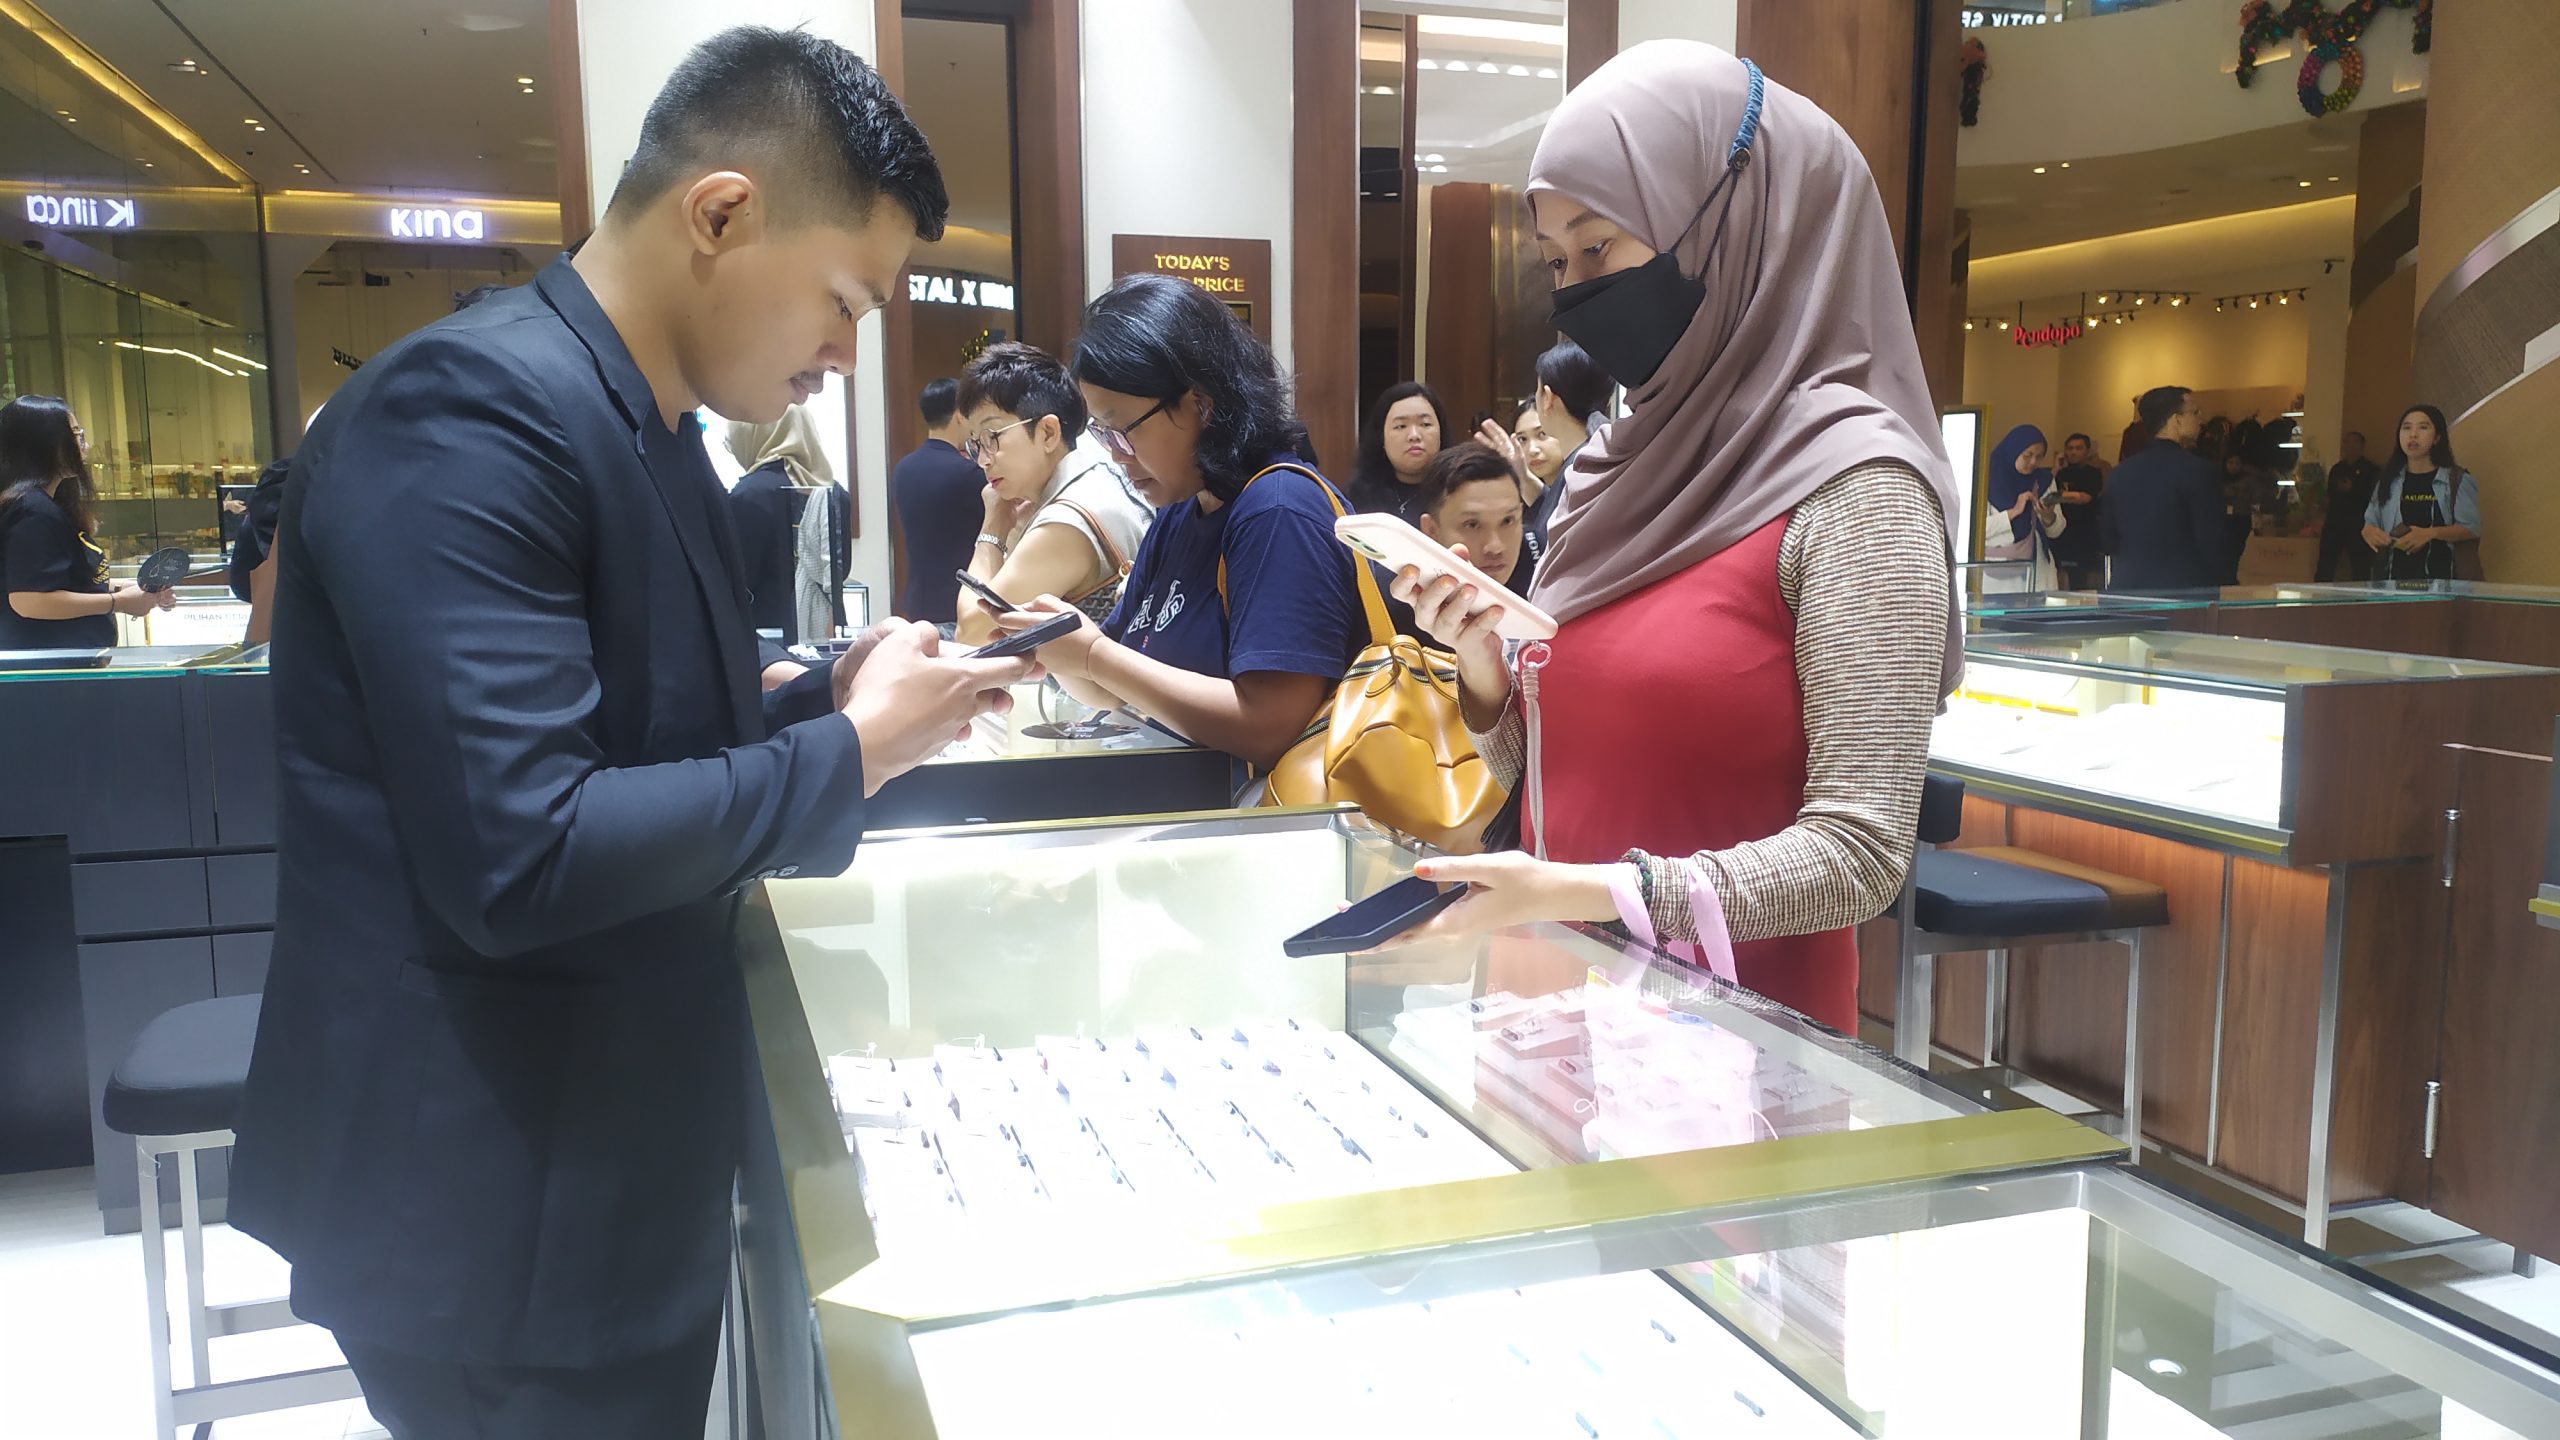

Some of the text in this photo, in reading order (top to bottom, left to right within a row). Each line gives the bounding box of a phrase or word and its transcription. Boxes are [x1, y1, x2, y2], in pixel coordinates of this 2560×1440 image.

[1154, 254, 1230, 271] TODAY'S
[961, 279, 978, 306] X
[1194, 276, 1245, 292] PRICE
[2013, 325, 2081, 350] Pendopo
